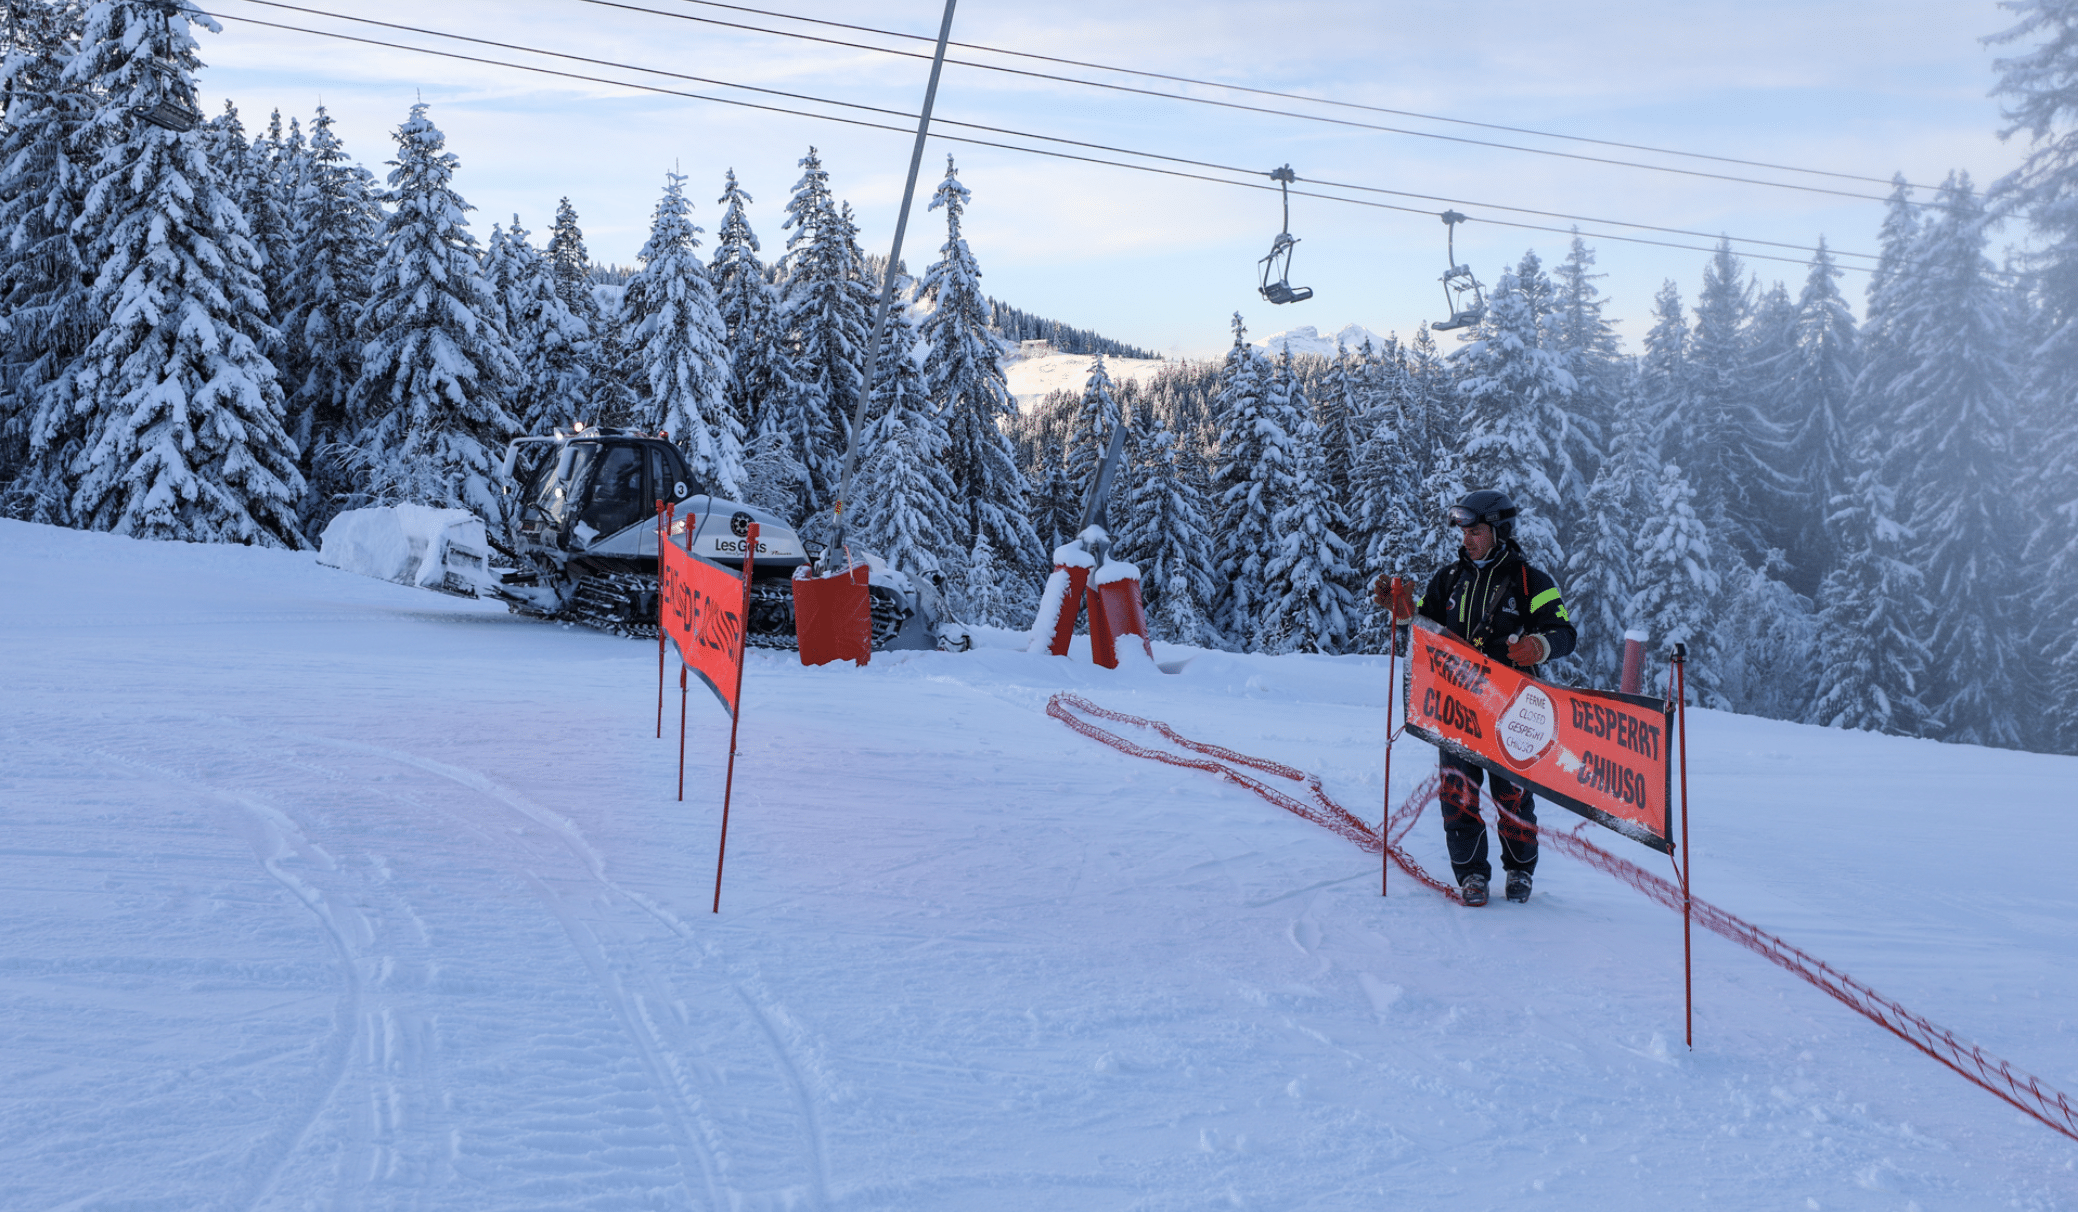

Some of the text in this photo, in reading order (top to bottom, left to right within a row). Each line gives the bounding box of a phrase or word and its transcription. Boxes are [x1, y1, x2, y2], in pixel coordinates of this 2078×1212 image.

[677, 484, 685, 496] 3
[715, 538, 737, 552] Les
[1426, 644, 1491, 696] FERMÉ
[1423, 687, 1483, 740] CLOSED
[1519, 708, 1546, 725] CLOSED
[1570, 697, 1660, 761] GESPERRT
[1577, 750, 1646, 810] CHIUSO
